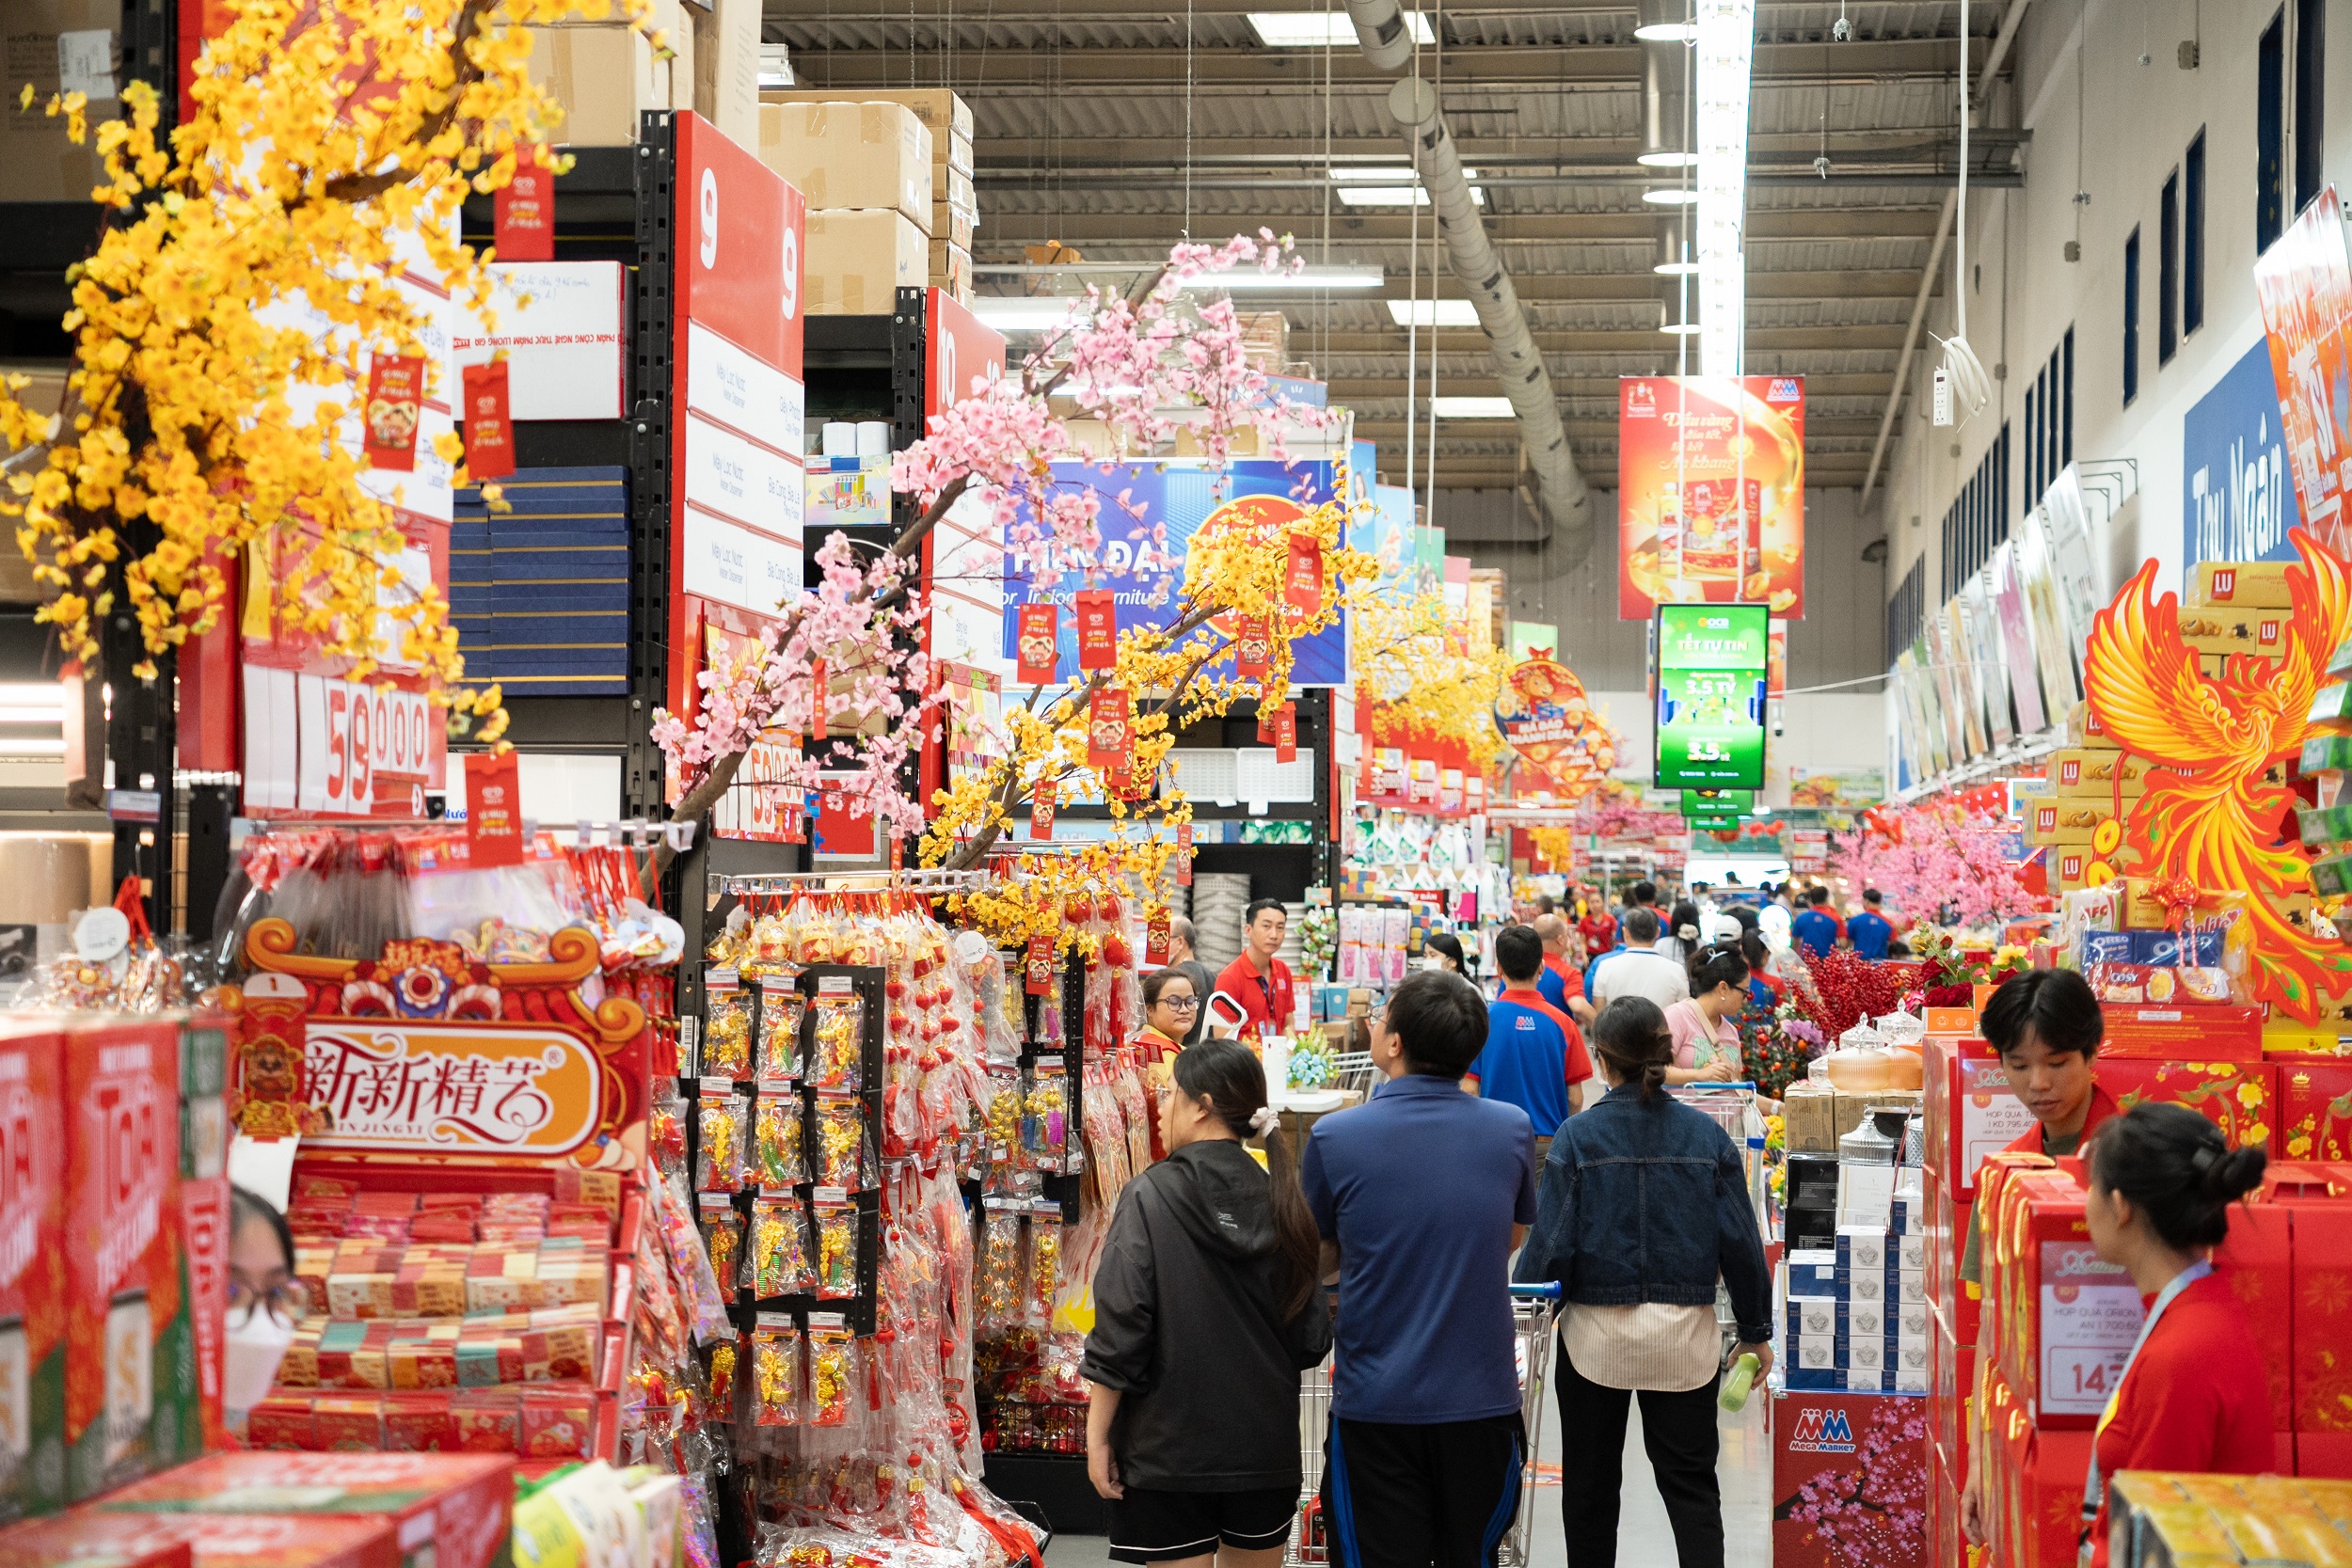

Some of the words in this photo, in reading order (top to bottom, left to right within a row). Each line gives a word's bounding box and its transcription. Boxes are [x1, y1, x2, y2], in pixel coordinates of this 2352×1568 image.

[699, 167, 719, 270] 9
[781, 228, 798, 320] 9
[940, 326, 956, 409] 10
[2192, 463, 2226, 562] Thu
[2230, 411, 2282, 562] Ngân
[2215, 573, 2233, 593] LU
[2262, 624, 2277, 640] LU
[1677, 632, 1701, 651] TẾT
[1724, 641, 1748, 651] TIN
[1685, 679, 1713, 695] 3.5
[1687, 742, 1721, 762] 3.5
[2063, 764, 2077, 779] LU
[2040, 811, 2054, 827] LU
[2065, 859, 2078, 875] LU
[2093, 935, 2129, 945] OREO
[2110, 972, 2138, 983] COSY
[2201, 984, 2217, 995] x3
[305, 1036, 548, 1144] 新新精艺
